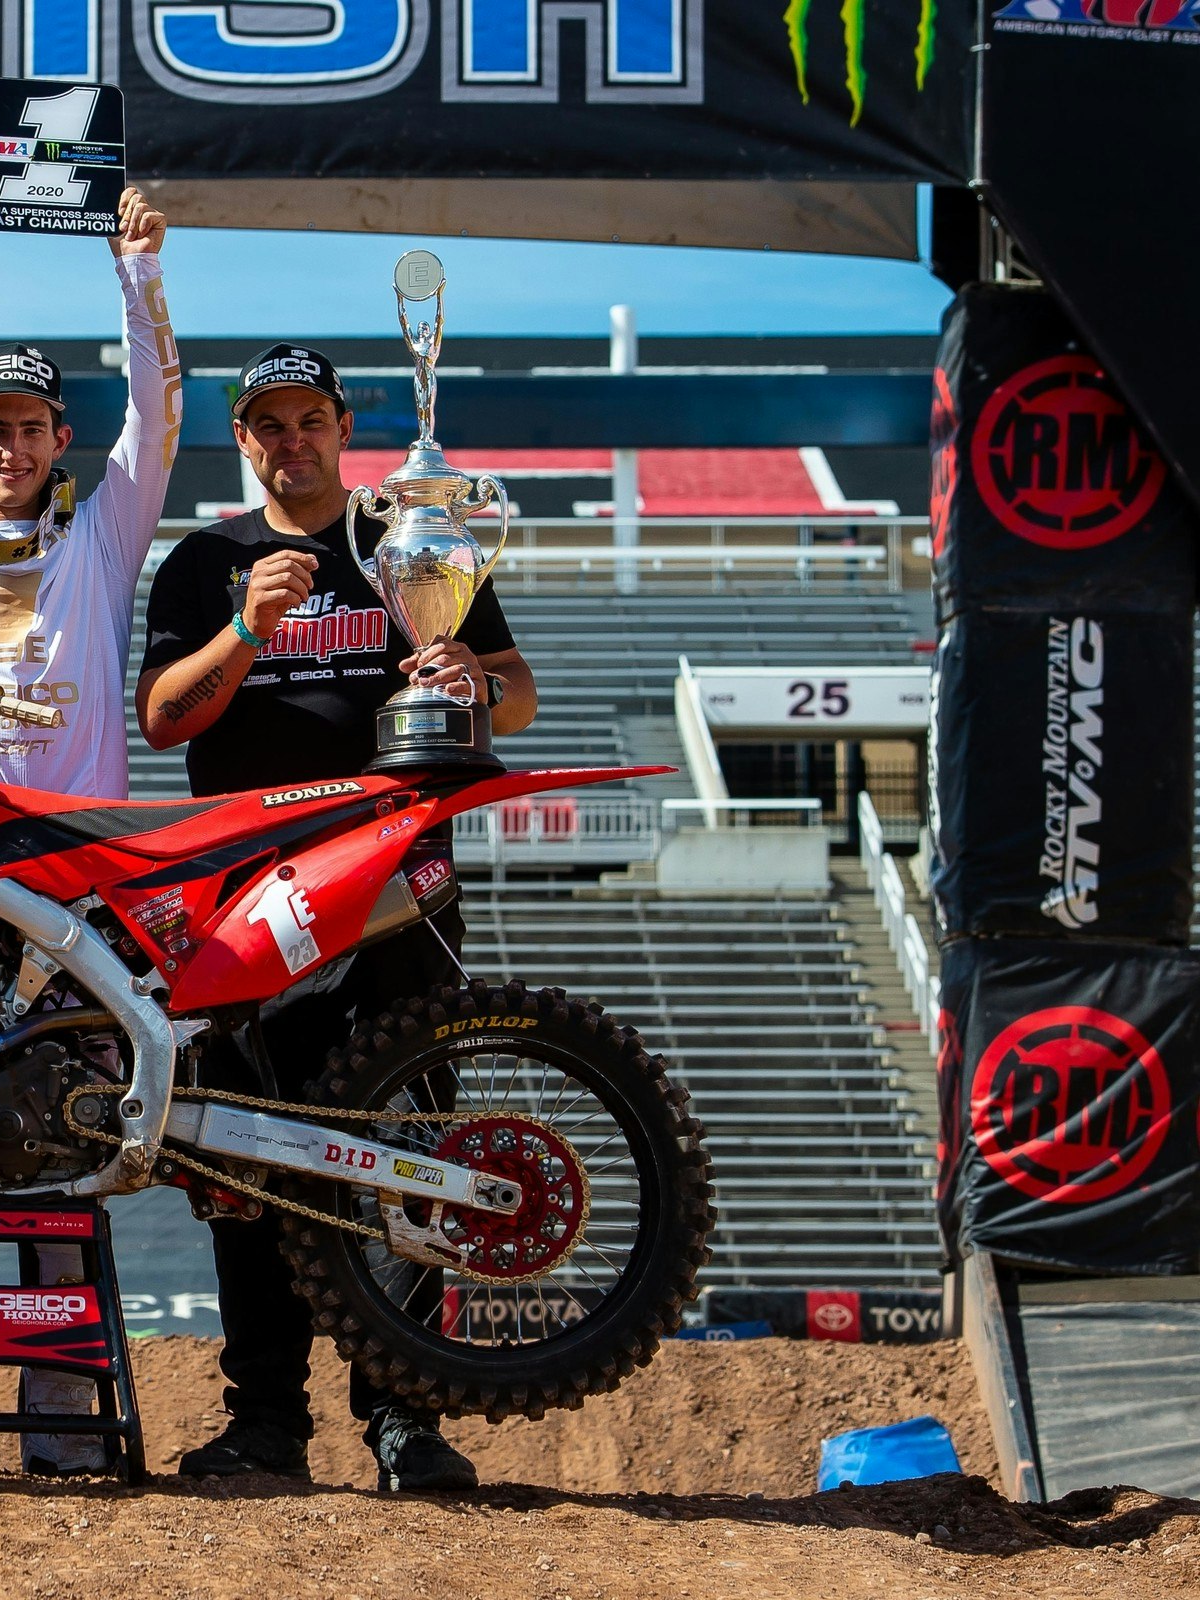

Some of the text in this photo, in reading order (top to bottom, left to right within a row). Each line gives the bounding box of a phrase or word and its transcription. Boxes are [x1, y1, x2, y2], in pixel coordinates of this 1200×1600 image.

[993, 20, 1064, 35] AMERICAN
[1066, 25, 1170, 43] MOTORCYCLIST
[27, 185, 64, 197] 2020
[10, 207, 81, 219] SUPERCROSS
[84, 212, 114, 221] 250SX
[29, 217, 116, 232] CHAMPION
[408, 261, 429, 288] E
[244, 358, 320, 387] GEICO
[253, 372, 316, 387] HONDA
[255, 604, 389, 663] ampion
[343, 667, 386, 676] HONDA
[788, 681, 849, 717] 25
[1039, 616, 1070, 882] ROCKY MOUNTAIN
[263, 781, 363, 806] HONDA
[434, 1016, 539, 1040] DUNLOP
[3, 1310, 74, 1322] HONDA
[11, 1319, 67, 1327] GEICOHONDA.COM
[469, 1300, 587, 1325] TOYOTA
[869, 1306, 941, 1333] TOY
